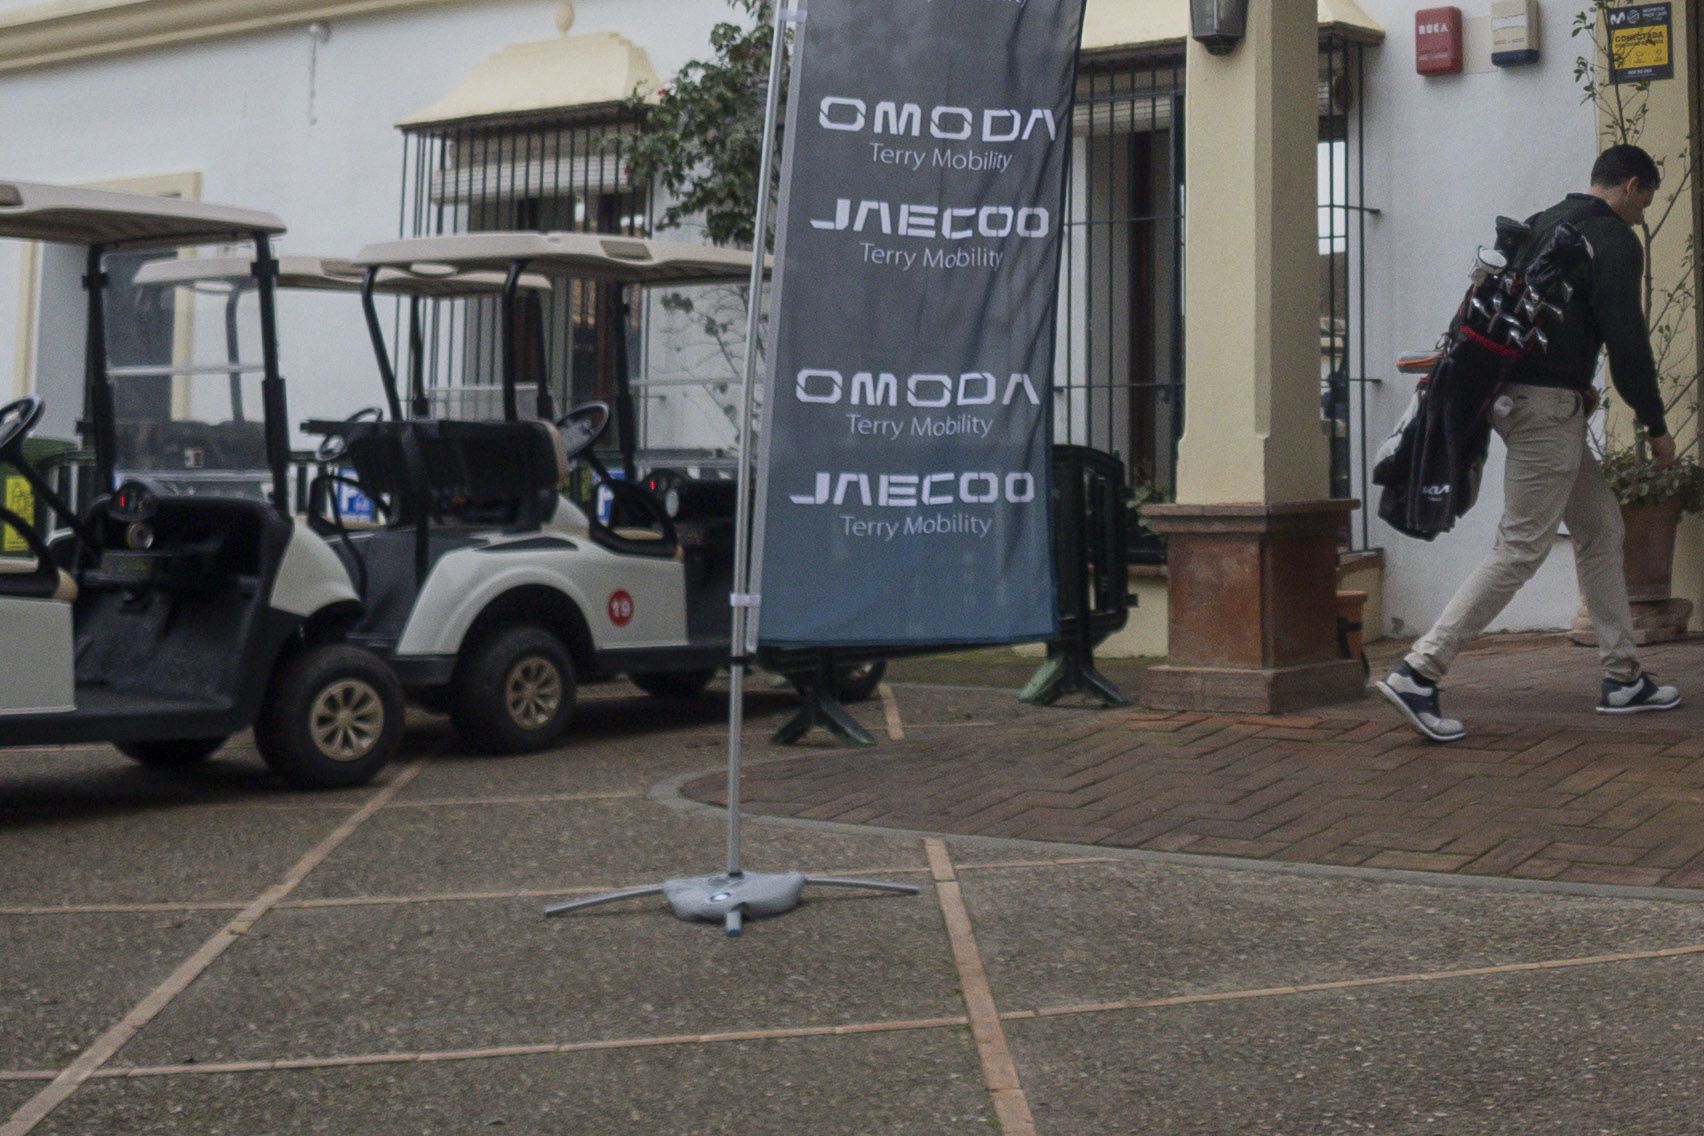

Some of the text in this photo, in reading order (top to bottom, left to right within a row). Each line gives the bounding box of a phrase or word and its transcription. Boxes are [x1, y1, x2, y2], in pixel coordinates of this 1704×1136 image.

[819, 96, 1056, 142] OMODA
[870, 142, 1012, 173] Terry Mobility
[810, 199, 1049, 239] JAECOO
[860, 242, 916, 271] Terry
[796, 369, 1040, 408] OMODA
[846, 414, 994, 440] Terry Mobility
[789, 472, 1035, 506] JAECOO
[840, 514, 992, 541] Terry Mobility
[611, 599, 631, 617] 19
